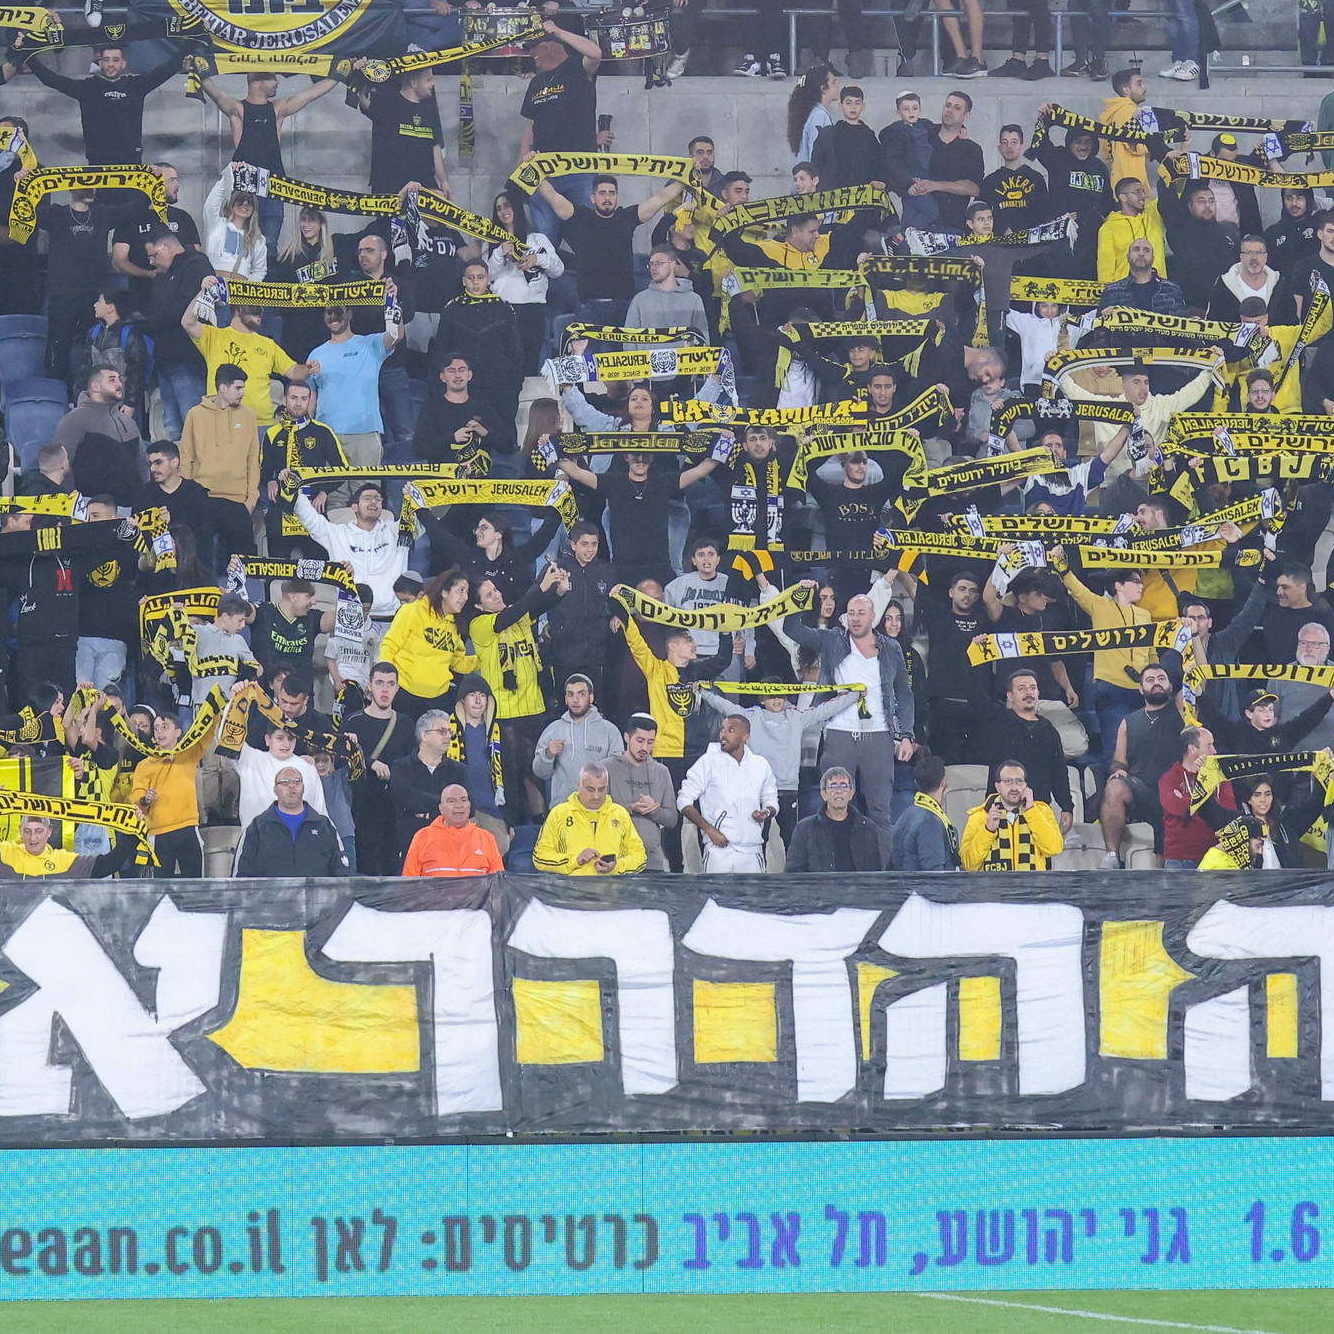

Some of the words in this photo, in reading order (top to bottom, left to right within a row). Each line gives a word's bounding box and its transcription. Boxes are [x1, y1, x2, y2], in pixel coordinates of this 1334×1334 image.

[537, 156, 618, 172] ירושלים
[625, 156, 686, 176] בית"ר
[42, 173, 134, 189] ירושלים
[994, 177, 1035, 195] LAKERS
[1117, 310, 1216, 331] ירושלים
[596, 332, 660, 343] JERUSALEM
[1075, 405, 1135, 422] JERUSALEM
[590, 433, 680, 450] Jerusalem
[424, 483, 483, 497] ירושלים
[491, 482, 548, 496] JERUSALEM
[1002, 518, 1100, 531] ירושלים
[1087, 552, 1157, 564] ירושלים
[1163, 552, 1215, 564] בית"ר
[640, 601, 736, 630] ירושלים
[739, 600, 791, 627] בית"ר
[1053, 629, 1148, 651] ירושלים
[322, 890, 1087, 1116] הדרך
[682, 1211, 801, 1270] אביב
[825, 1203, 886, 1268] תל
[909, 1208, 1098, 1276] יהושע,
[1120, 1207, 1191, 1265] גני
[1245, 1201, 1320, 1263] 1.6
[310, 1207, 398, 1283] לאן
[421, 1213, 659, 1273] כרטיסים:
